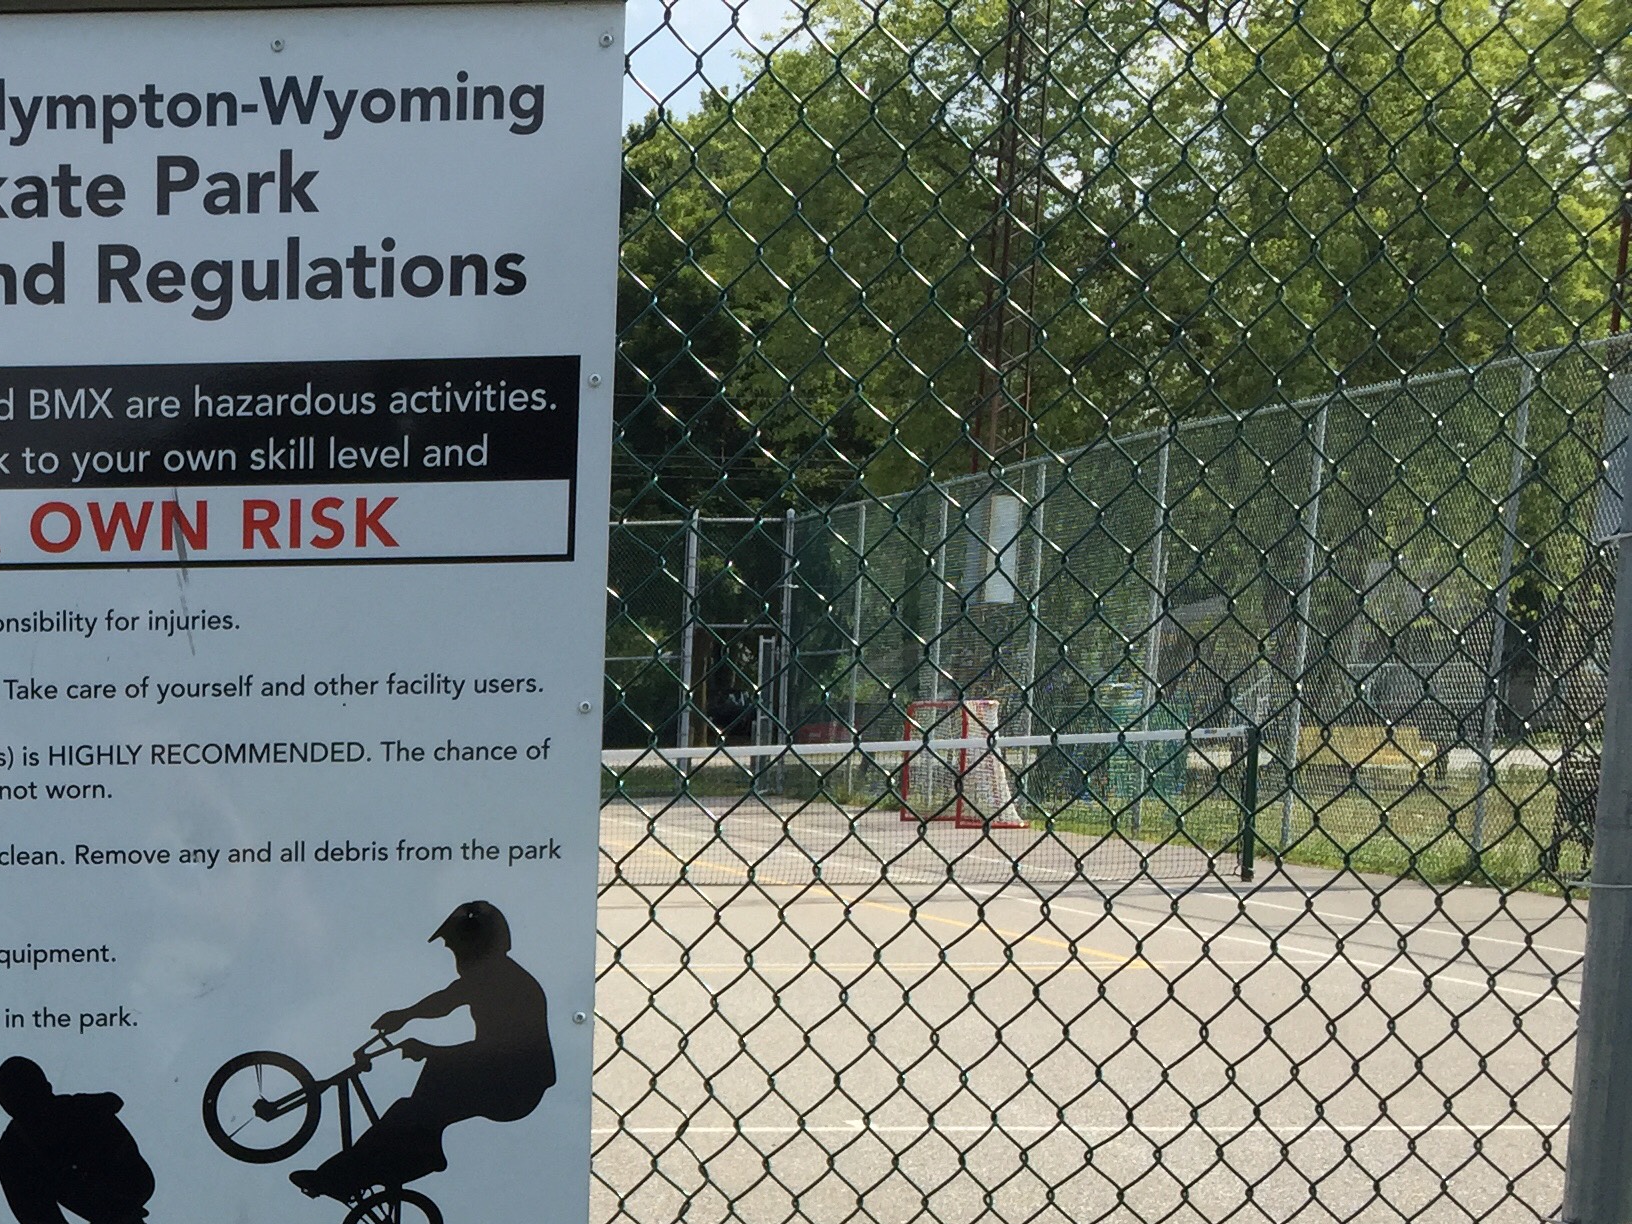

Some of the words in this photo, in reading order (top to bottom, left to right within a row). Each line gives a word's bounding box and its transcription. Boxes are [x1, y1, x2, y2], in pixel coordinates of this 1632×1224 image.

[157, 149, 319, 215] Park
[98, 237, 526, 321] Regulations
[30, 388, 113, 419] BMX
[126, 396, 180, 418] are
[195, 382, 375, 417] hazardous
[390, 380, 556, 413] activities.
[22, 447, 59, 474] to
[72, 451, 150, 482] your
[164, 449, 236, 471] own
[250, 437, 314, 470] skill
[330, 435, 408, 468] level
[423, 433, 487, 467] and
[30, 500, 207, 557] OWN
[243, 497, 399, 549] RISK
[105, 609, 139, 631] for
[149, 610, 239, 637] injuries.
